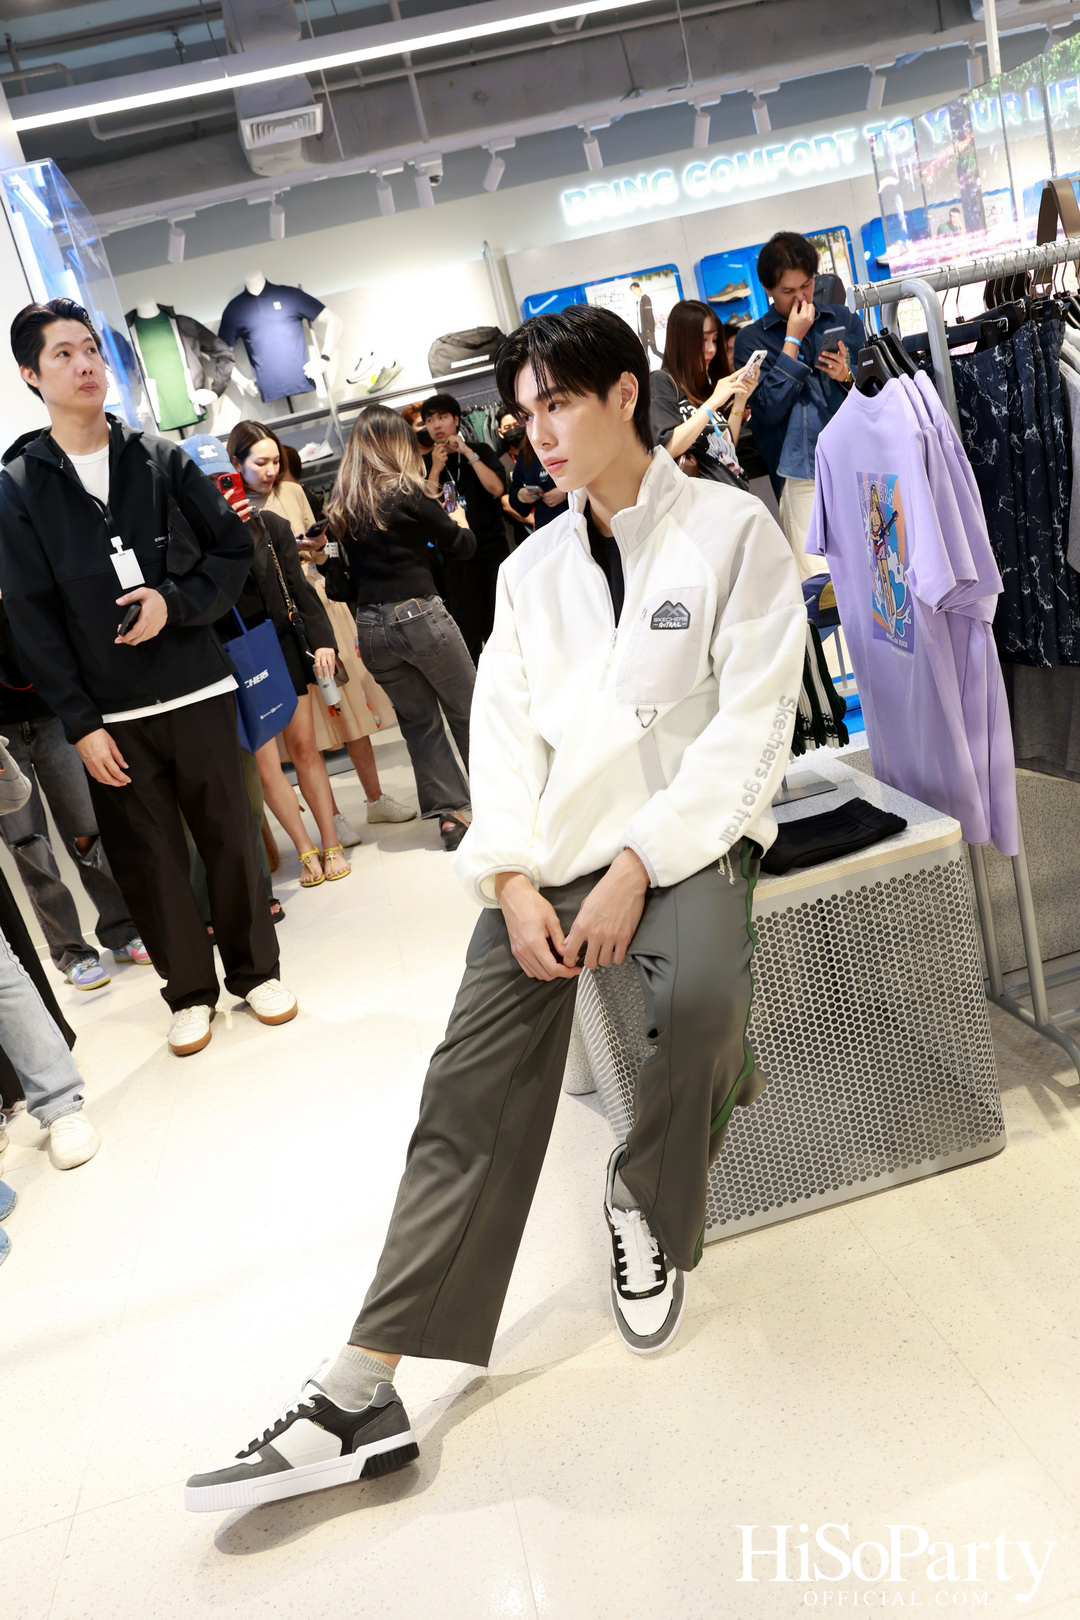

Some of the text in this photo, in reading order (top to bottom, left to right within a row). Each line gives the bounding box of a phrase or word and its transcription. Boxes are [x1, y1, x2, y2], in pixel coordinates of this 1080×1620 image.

[562, 77, 1080, 225] BRING COMFORT TO YUR LIF
[244, 669, 269, 689] CHERS
[742, 779, 763, 807] go
[718, 808, 752, 847] trail
